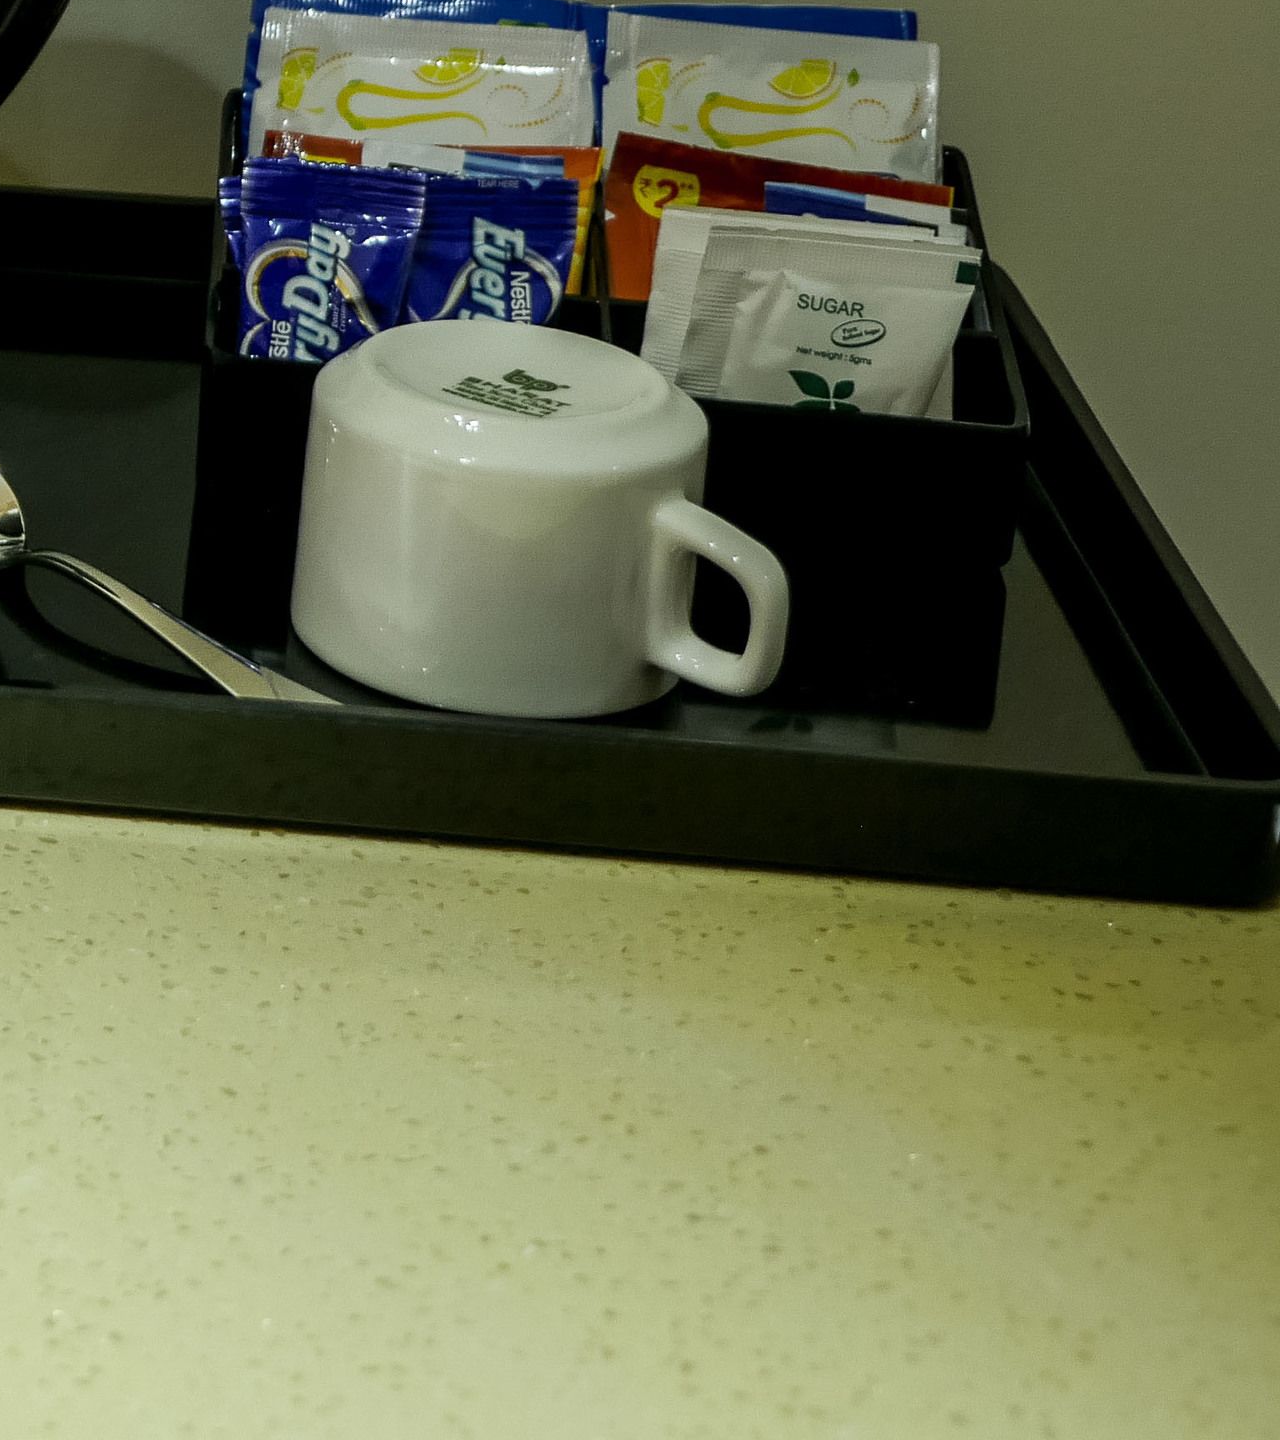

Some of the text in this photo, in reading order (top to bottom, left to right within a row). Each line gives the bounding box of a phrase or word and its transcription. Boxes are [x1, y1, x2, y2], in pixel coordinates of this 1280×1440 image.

[477, 179, 520, 188] TEAR HERE
[510, 271, 531, 325] Nestl
[796, 293, 864, 318] SUGAR
[796, 346, 812, 355] Net
